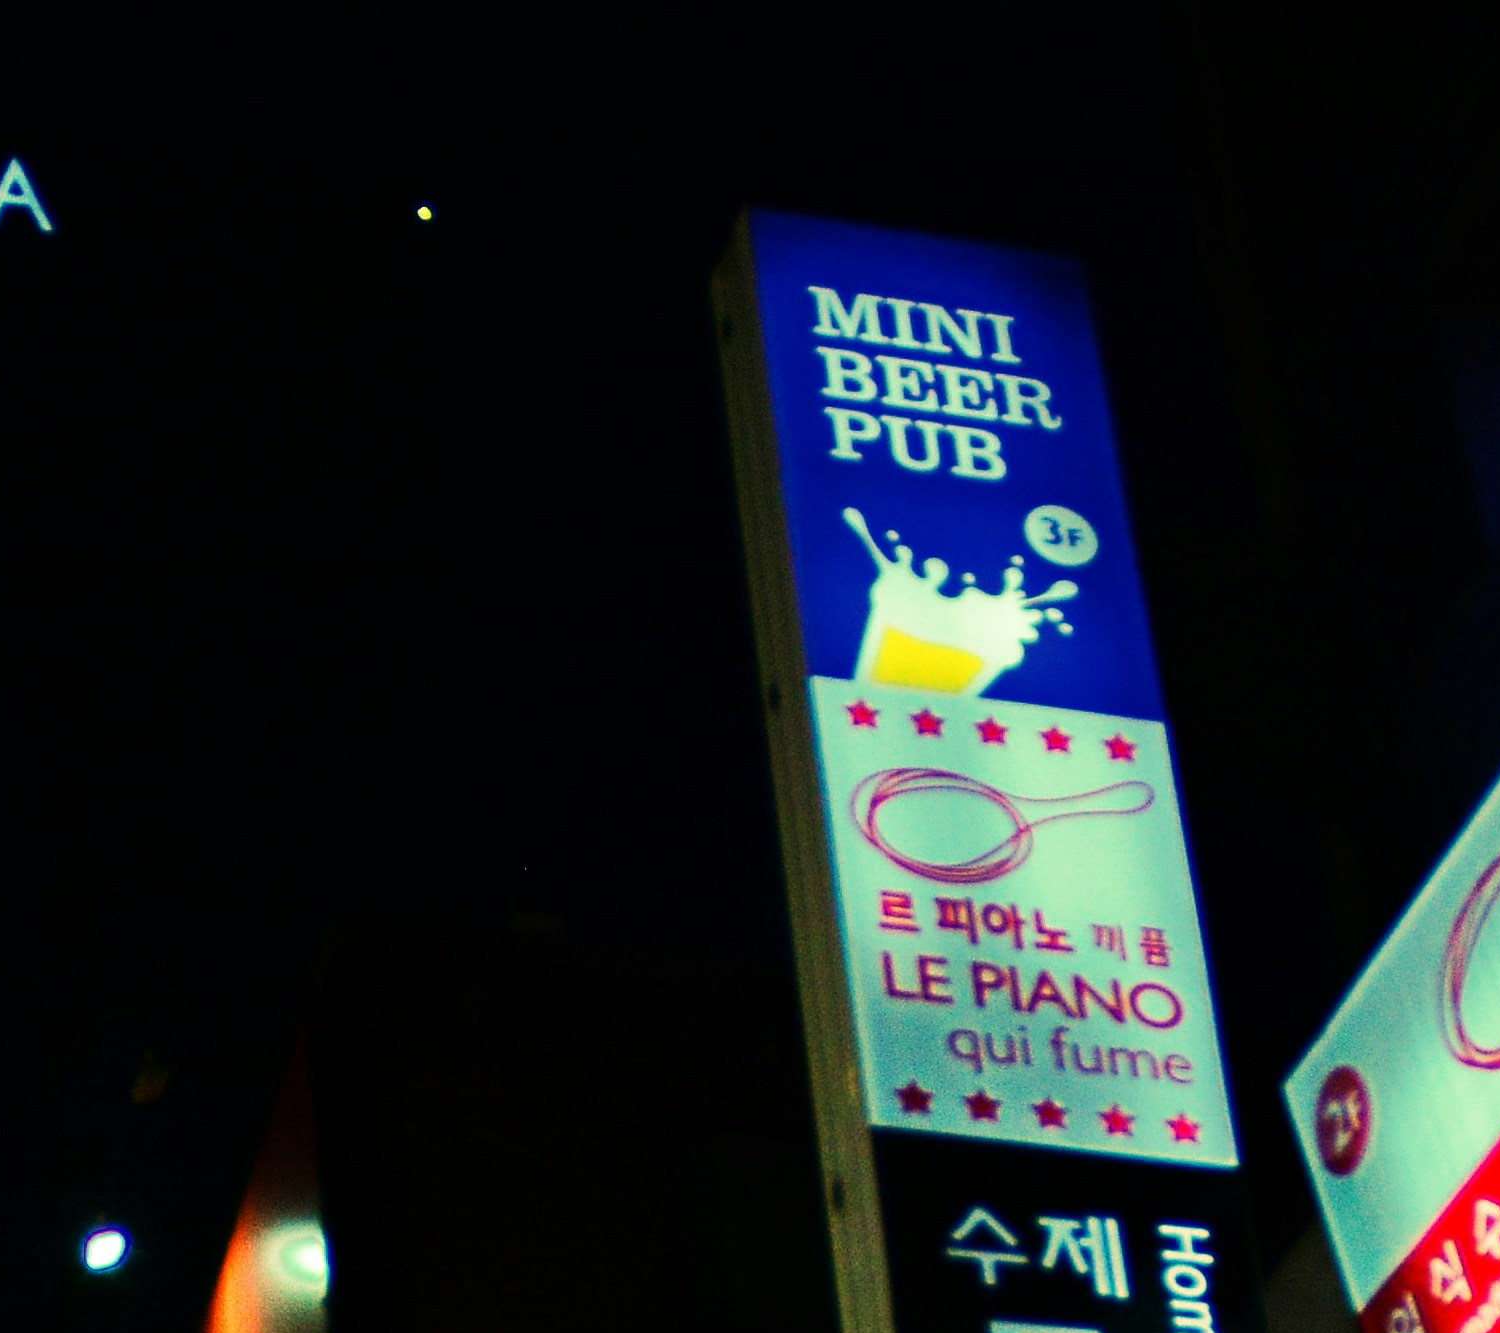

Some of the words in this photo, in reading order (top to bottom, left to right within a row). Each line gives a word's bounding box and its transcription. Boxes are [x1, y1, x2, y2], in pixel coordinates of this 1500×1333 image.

[807, 285, 1023, 364] MINI
[815, 345, 1063, 430] BEER
[823, 406, 1008, 481] PUB
[878, 889, 921, 933] 르
[933, 896, 1074, 954] 피아노
[880, 950, 954, 1005] LE
[970, 959, 1184, 1030] PIANO
[946, 1024, 1035, 1074] qui
[1049, 1024, 1194, 1085] fume
[945, 1206, 1131, 1300] 수제
